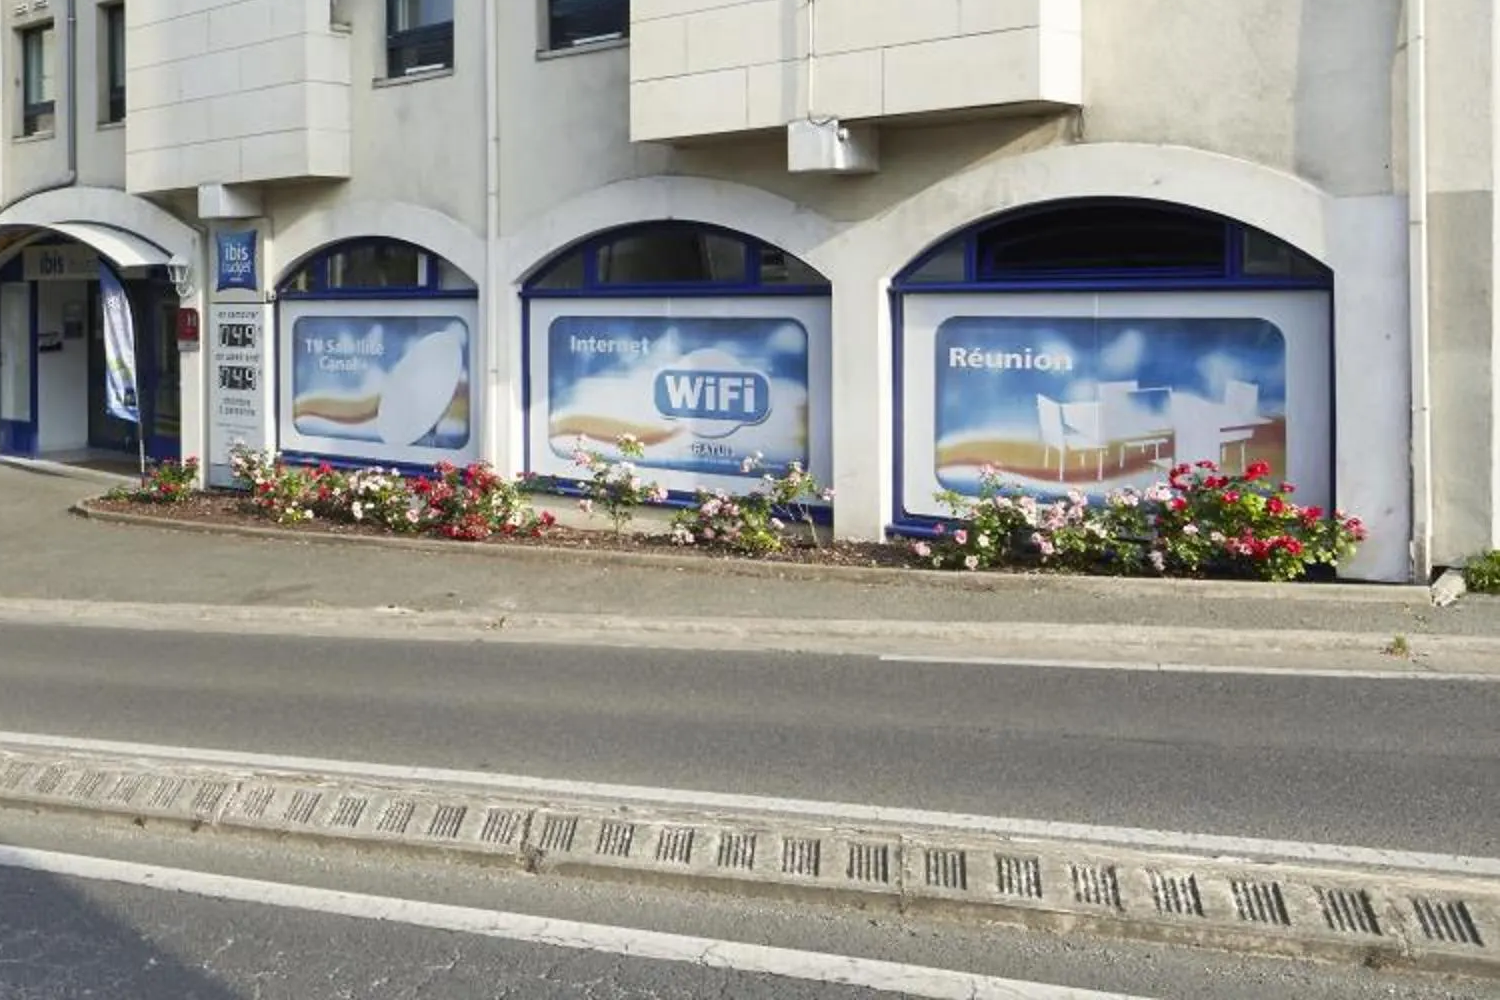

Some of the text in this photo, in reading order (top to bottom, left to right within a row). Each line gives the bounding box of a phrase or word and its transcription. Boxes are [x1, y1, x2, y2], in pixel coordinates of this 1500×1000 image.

[224, 242, 249, 261] ibis
[570, 335, 650, 355] Internet
[948, 345, 1074, 373] Réunion
[665, 374, 756, 414] WiFi
